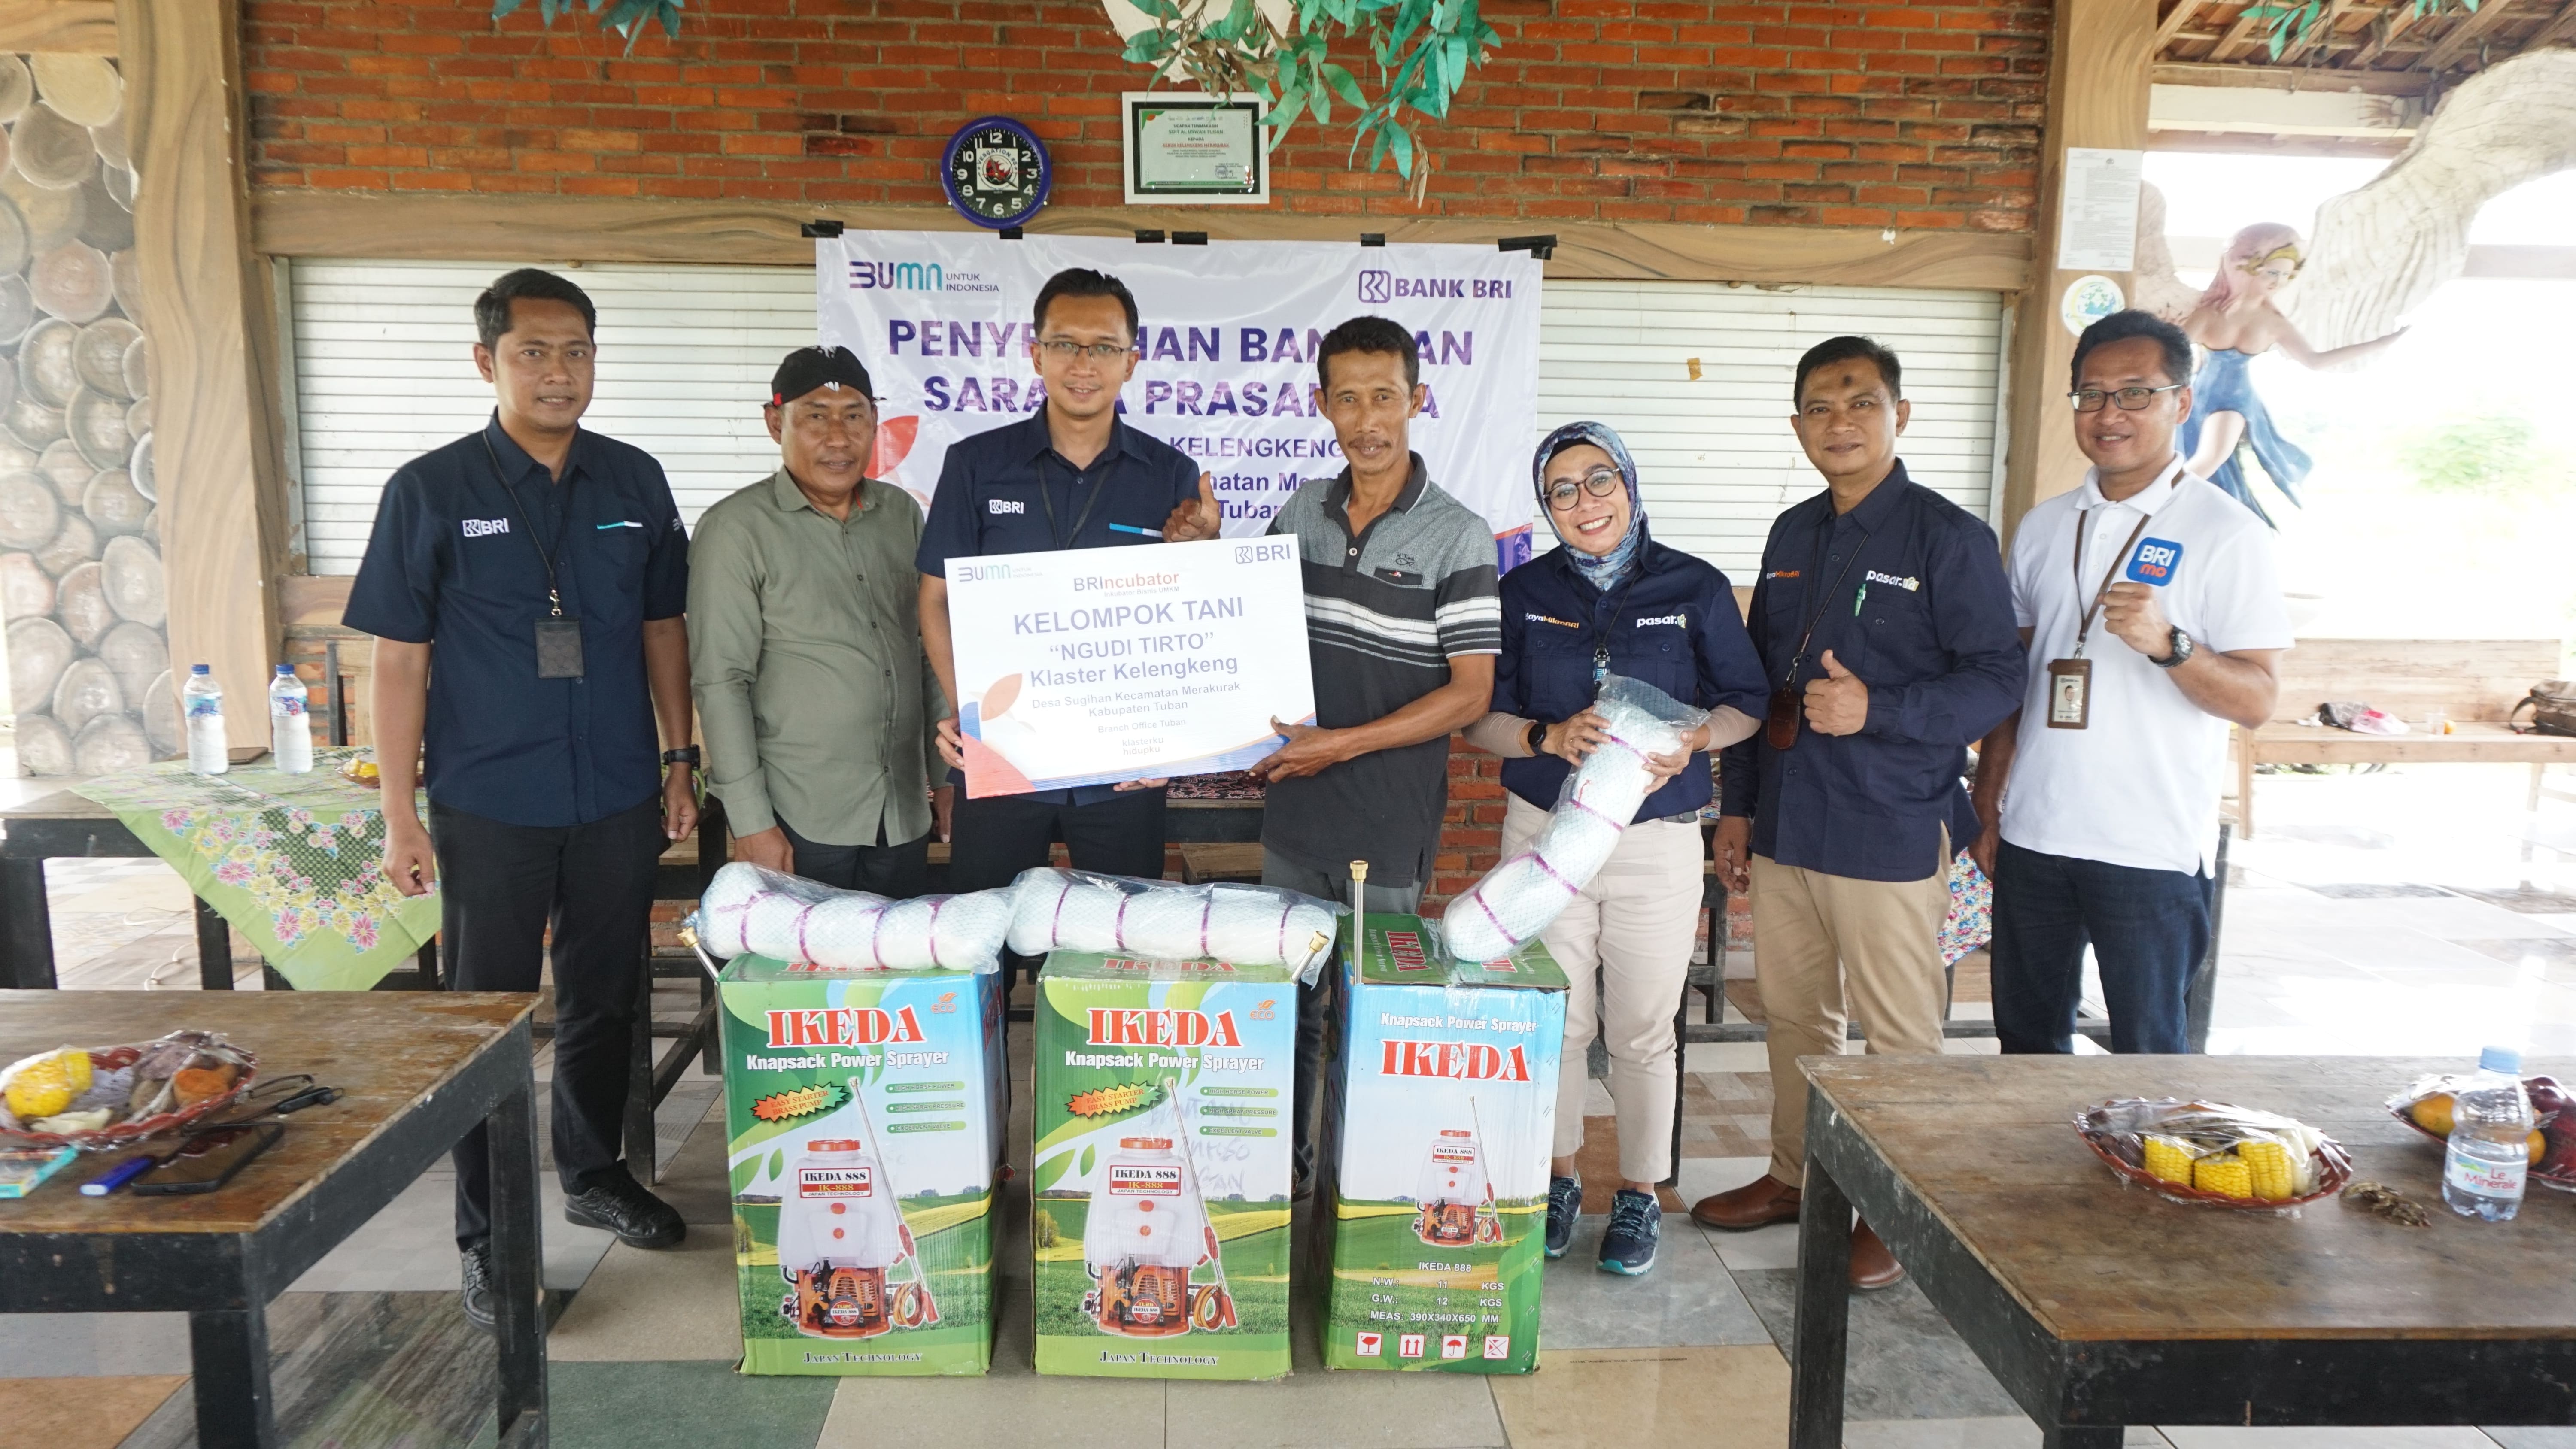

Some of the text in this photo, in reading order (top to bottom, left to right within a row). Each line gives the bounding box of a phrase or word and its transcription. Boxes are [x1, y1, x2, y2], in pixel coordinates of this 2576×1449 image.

[975, 137, 982, 149] 11
[990, 132, 1002, 143] 12
[1013, 136, 1016, 147] 1
[963, 151, 974, 162] 10
[1021, 151, 1031, 161] 2
[957, 168, 968, 180] 9
[1026, 168, 1037, 179] 3
[962, 185, 974, 196] 8
[1024, 184, 1034, 195] 4
[976, 198, 986, 209] 7
[993, 203, 1004, 215] 6
[1011, 197, 1022, 209] 5
[946, 273, 980, 281] UNTUK
[946, 284, 999, 292] INDONESIA
[1395, 278, 1512, 299] BANK BRI
[1003, 501, 1024, 514] BRI
[482, 518, 510, 535] BRI
[1256, 543, 1291, 562] BRI
[2138, 545, 2176, 567] BRI
[2139, 564, 2167, 578] mo
[1074, 572, 1180, 592] BRIncubator
[1014, 597, 1244, 636] KELOMPOK TANI
[1030, 655, 1239, 688] Klaster Kelengkeng
[1033, 682, 1240, 709] Desa Sugihan Kecamatan Merakurak
[1089, 701, 1188, 717] Kabupaten Tuban
[1098, 718, 1186, 733] Branch Office Tuban
[1122, 736, 1164, 747] klasterku
[1123, 746, 1160, 755] hidupku
[930, 1003, 957, 1013] ECO
[1250, 1009, 1276, 1020] ECO
[766, 1005, 927, 1048] IKEDA
[1086, 1008, 1244, 1049] IKEDA
[1380, 1012, 1537, 1035] Knapsack Power Sprayer
[747, 1050, 949, 1073] Knapsack Power Sprayer
[1065, 1050, 1264, 1073] Knapsack Power Sprayer
[1379, 1040, 1531, 1082] IKEDA
[770, 1090, 829, 1108] EASY STARTER
[1086, 1088, 1145, 1105] EASY STARTER
[772, 1099, 822, 1115] BRASS PUMP
[1088, 1097, 1137, 1112] BRASS PUMP
[805, 1172, 866, 1181] IKEDA 888
[1115, 1170, 1176, 1179] IKEDA 888
[2490, 1167, 2506, 1180] Le
[2464, 1172, 2518, 1190] Minerale
[1419, 1262, 1472, 1273] IKEDA 888
[1373, 1277, 1505, 1291] N.W.: 11 KGS
[1372, 1294, 1503, 1307] G.W.: 12 KGS
[1370, 1310, 1499, 1323] MEAS: 390X340X650 MM
[803, 1352, 923, 1364] JAPAN TECHNOLOGY
[1100, 1351, 1219, 1366] JAPAN TECHNOLOGY
